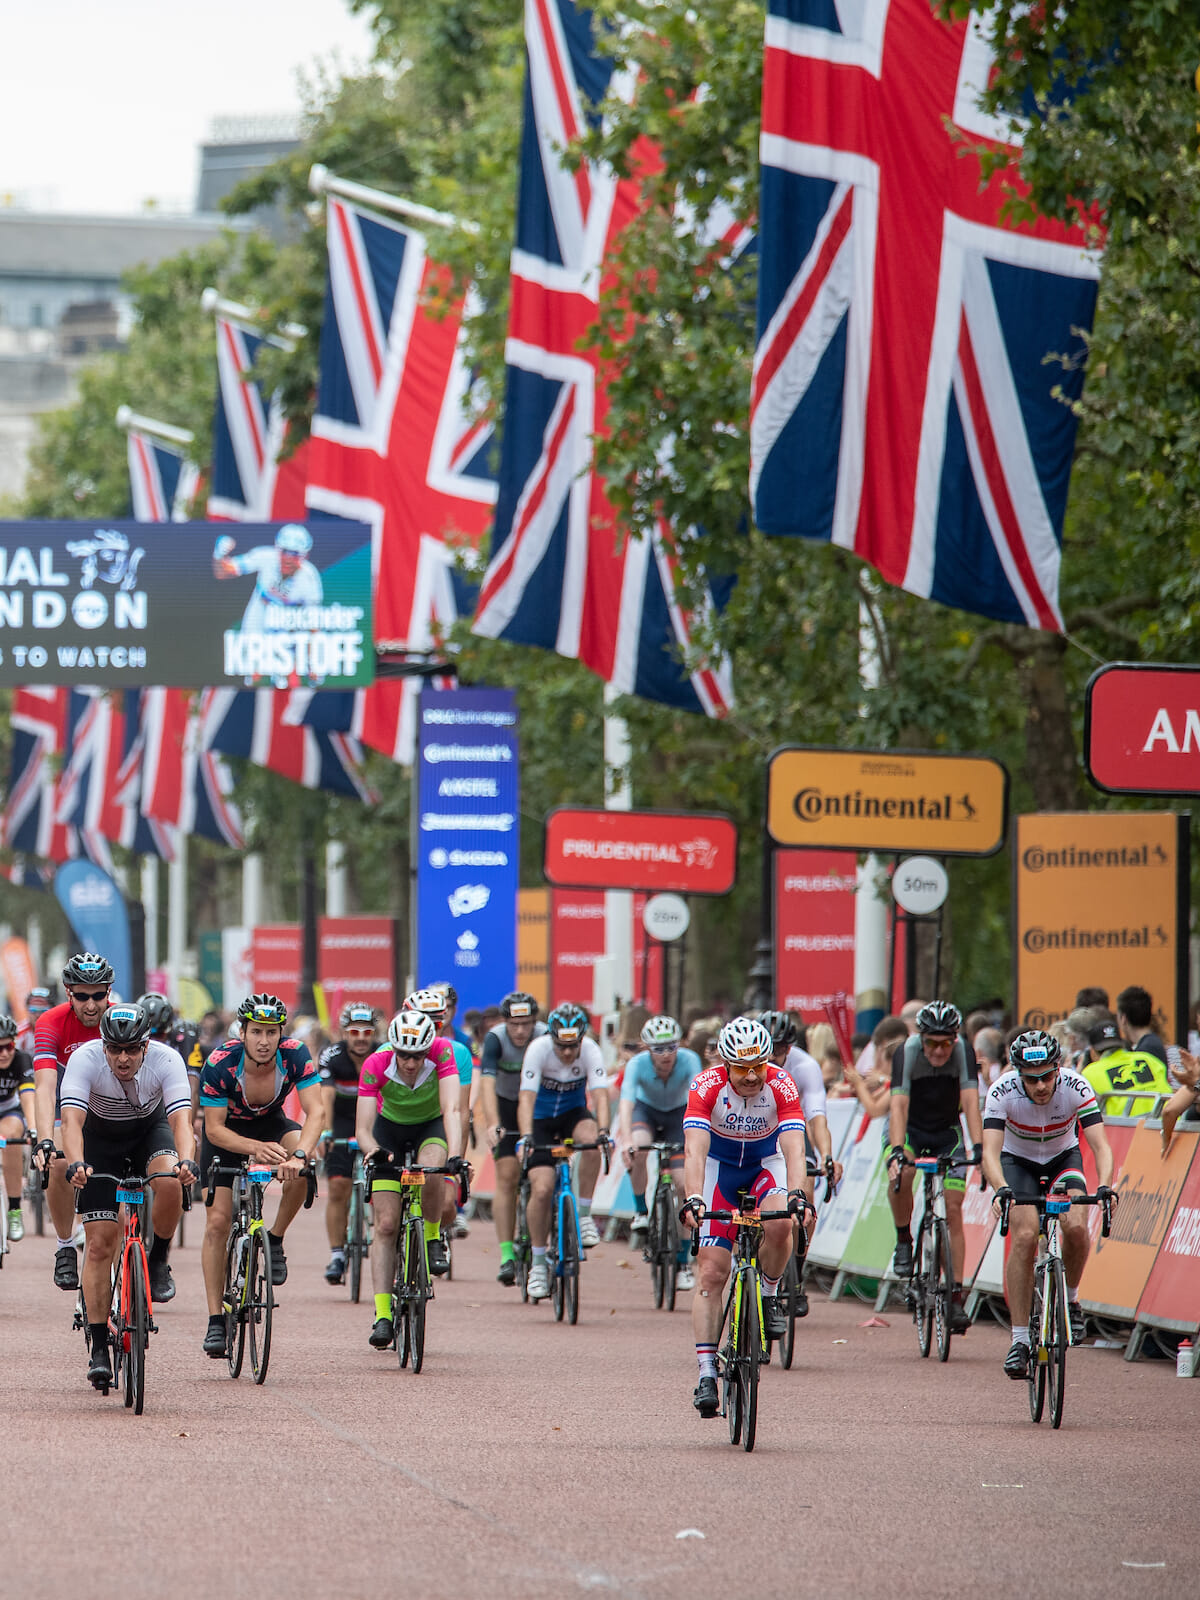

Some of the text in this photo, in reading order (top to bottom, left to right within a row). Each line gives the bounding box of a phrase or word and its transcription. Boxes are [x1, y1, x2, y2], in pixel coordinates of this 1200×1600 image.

[13, 646, 49, 667] TO
[57, 646, 147, 668] WATCH
[224, 629, 365, 677] KRISTOFF
[793, 787, 952, 823] Continental
[562, 838, 682, 864] PRUDENTIAL
[1023, 845, 1148, 873] Continental
[903, 876, 939, 893] 50m
[1023, 926, 1149, 953] Continental
[696, 1069, 720, 1083] ROYAL
[1063, 1074, 1091, 1099] PMCC
[783, 1077, 800, 1100] ROYAL
[737, 1116, 768, 1124] ROYAL
[737, 1123, 768, 1132] FORCE
